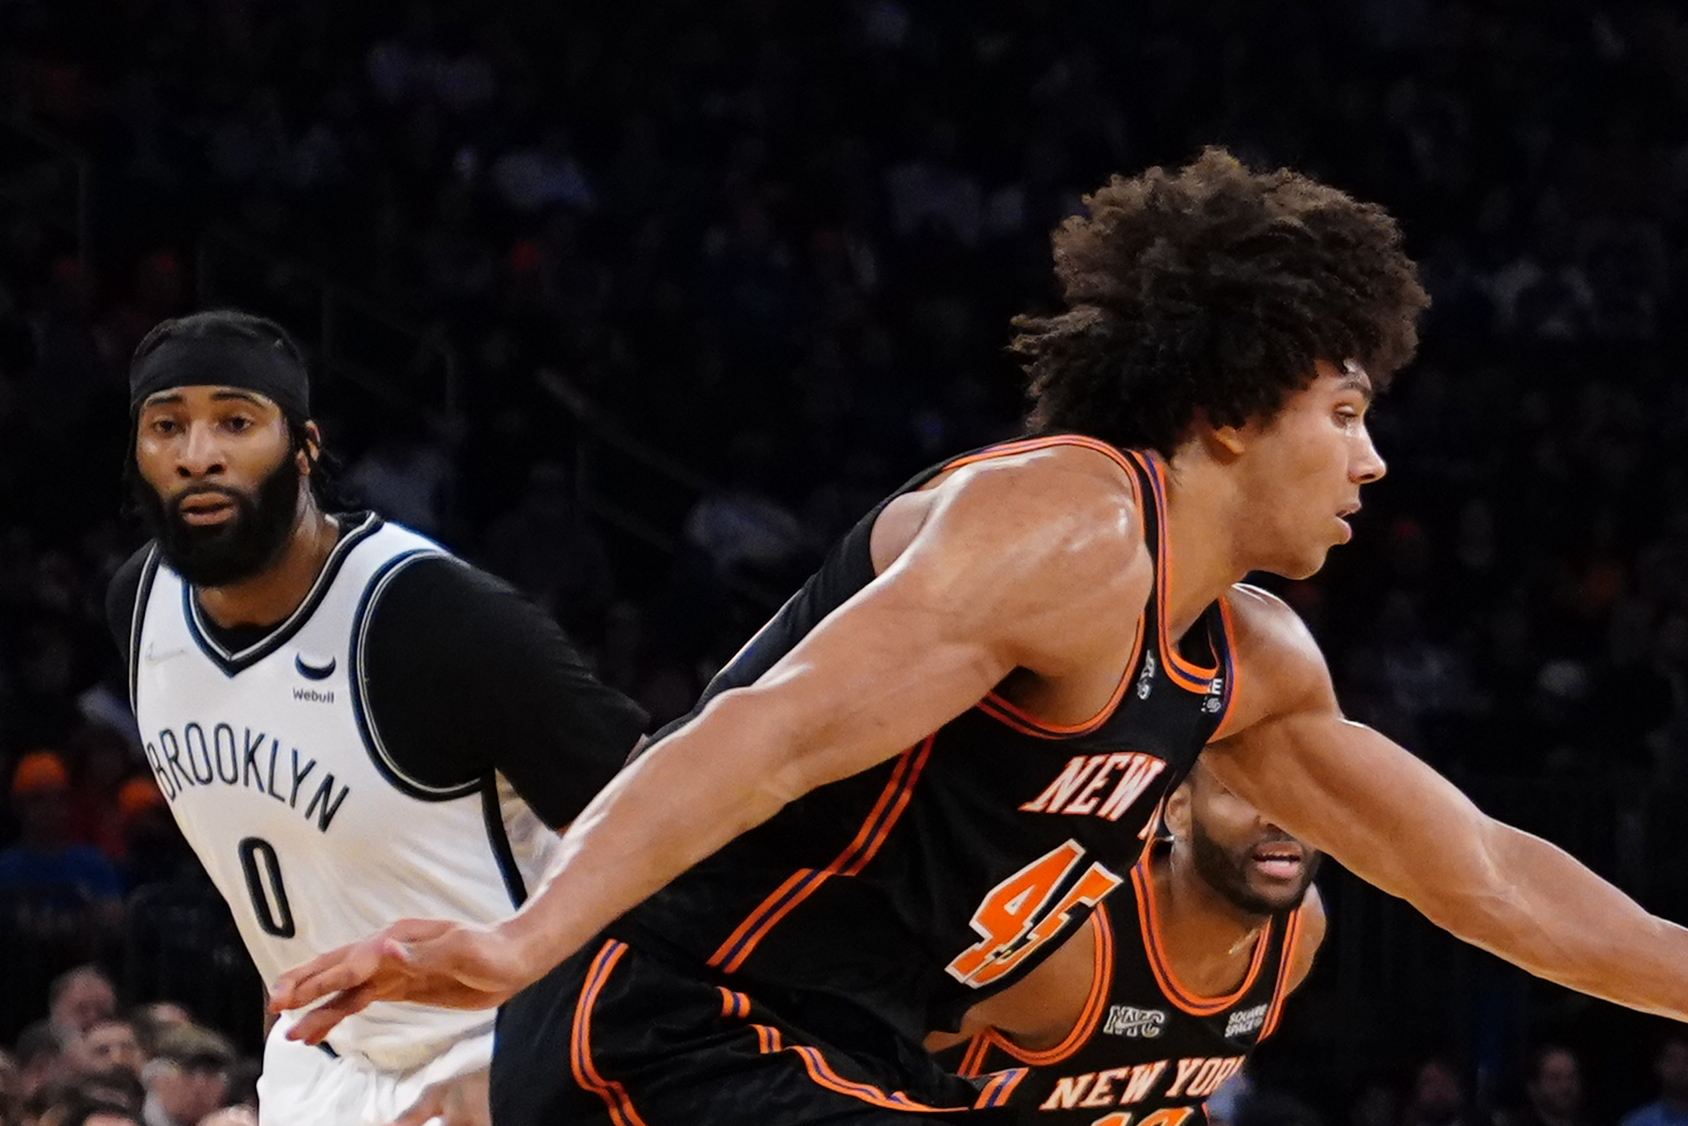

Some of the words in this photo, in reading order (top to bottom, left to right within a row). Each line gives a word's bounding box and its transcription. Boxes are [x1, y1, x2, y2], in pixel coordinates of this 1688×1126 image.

[293, 686, 335, 704] Webull
[147, 722, 350, 833] BROOKLYN
[1018, 752, 1167, 822] NEW
[238, 836, 295, 939] 0
[944, 838, 1124, 989] 45
[1038, 1058, 1171, 1111] NEW
